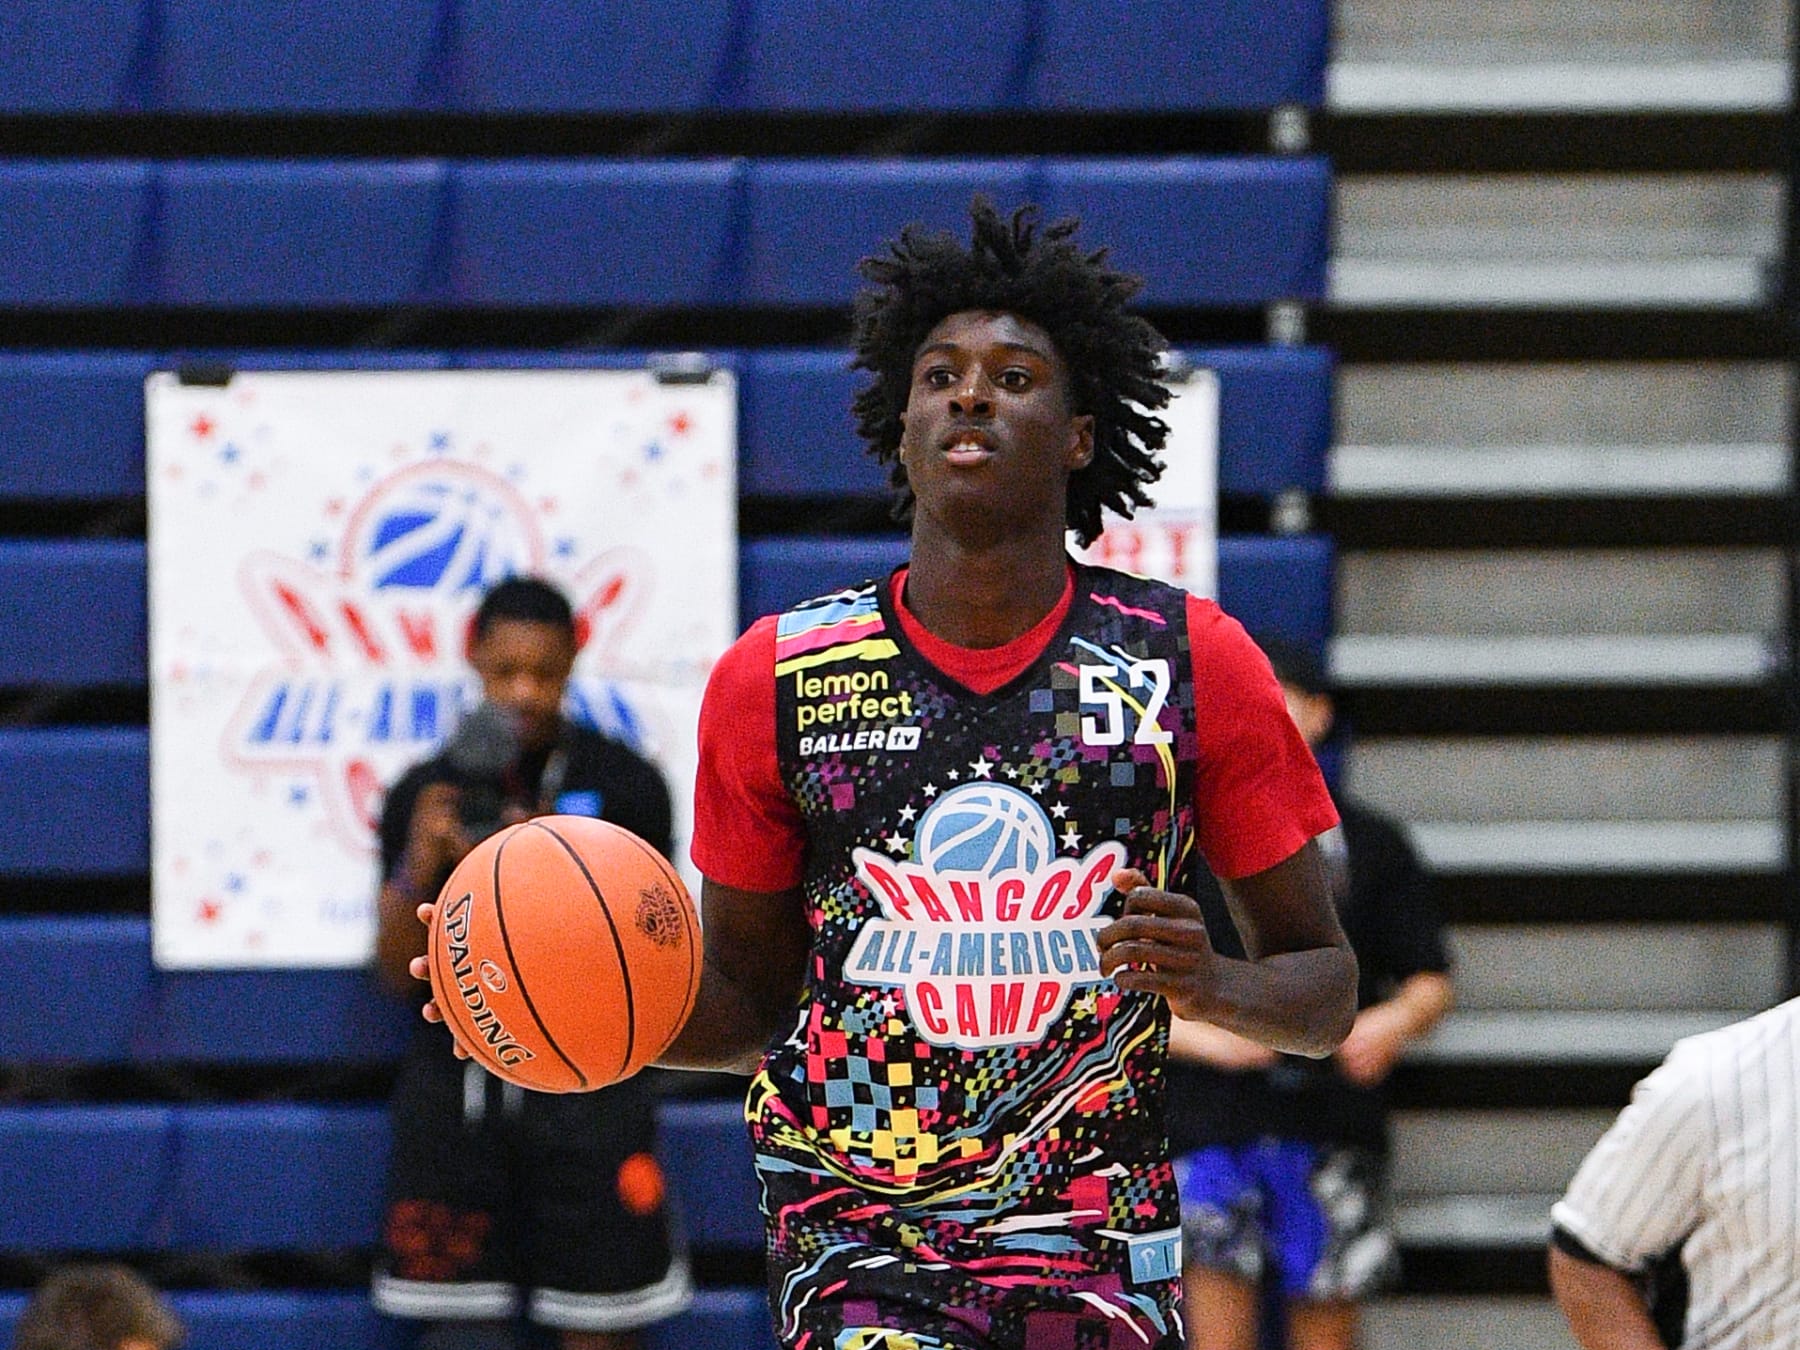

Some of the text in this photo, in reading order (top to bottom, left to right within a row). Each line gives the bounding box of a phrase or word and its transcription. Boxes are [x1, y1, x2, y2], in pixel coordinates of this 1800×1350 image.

[796, 670, 889, 698] lemon
[797, 691, 913, 732] perfect
[1080, 659, 1173, 746] 52
[864, 854, 1116, 922] PANGOS
[445, 892, 536, 1066] SPALDING
[856, 928, 1101, 976] ALL-AMERICA
[916, 982, 1061, 1037] CAMP
